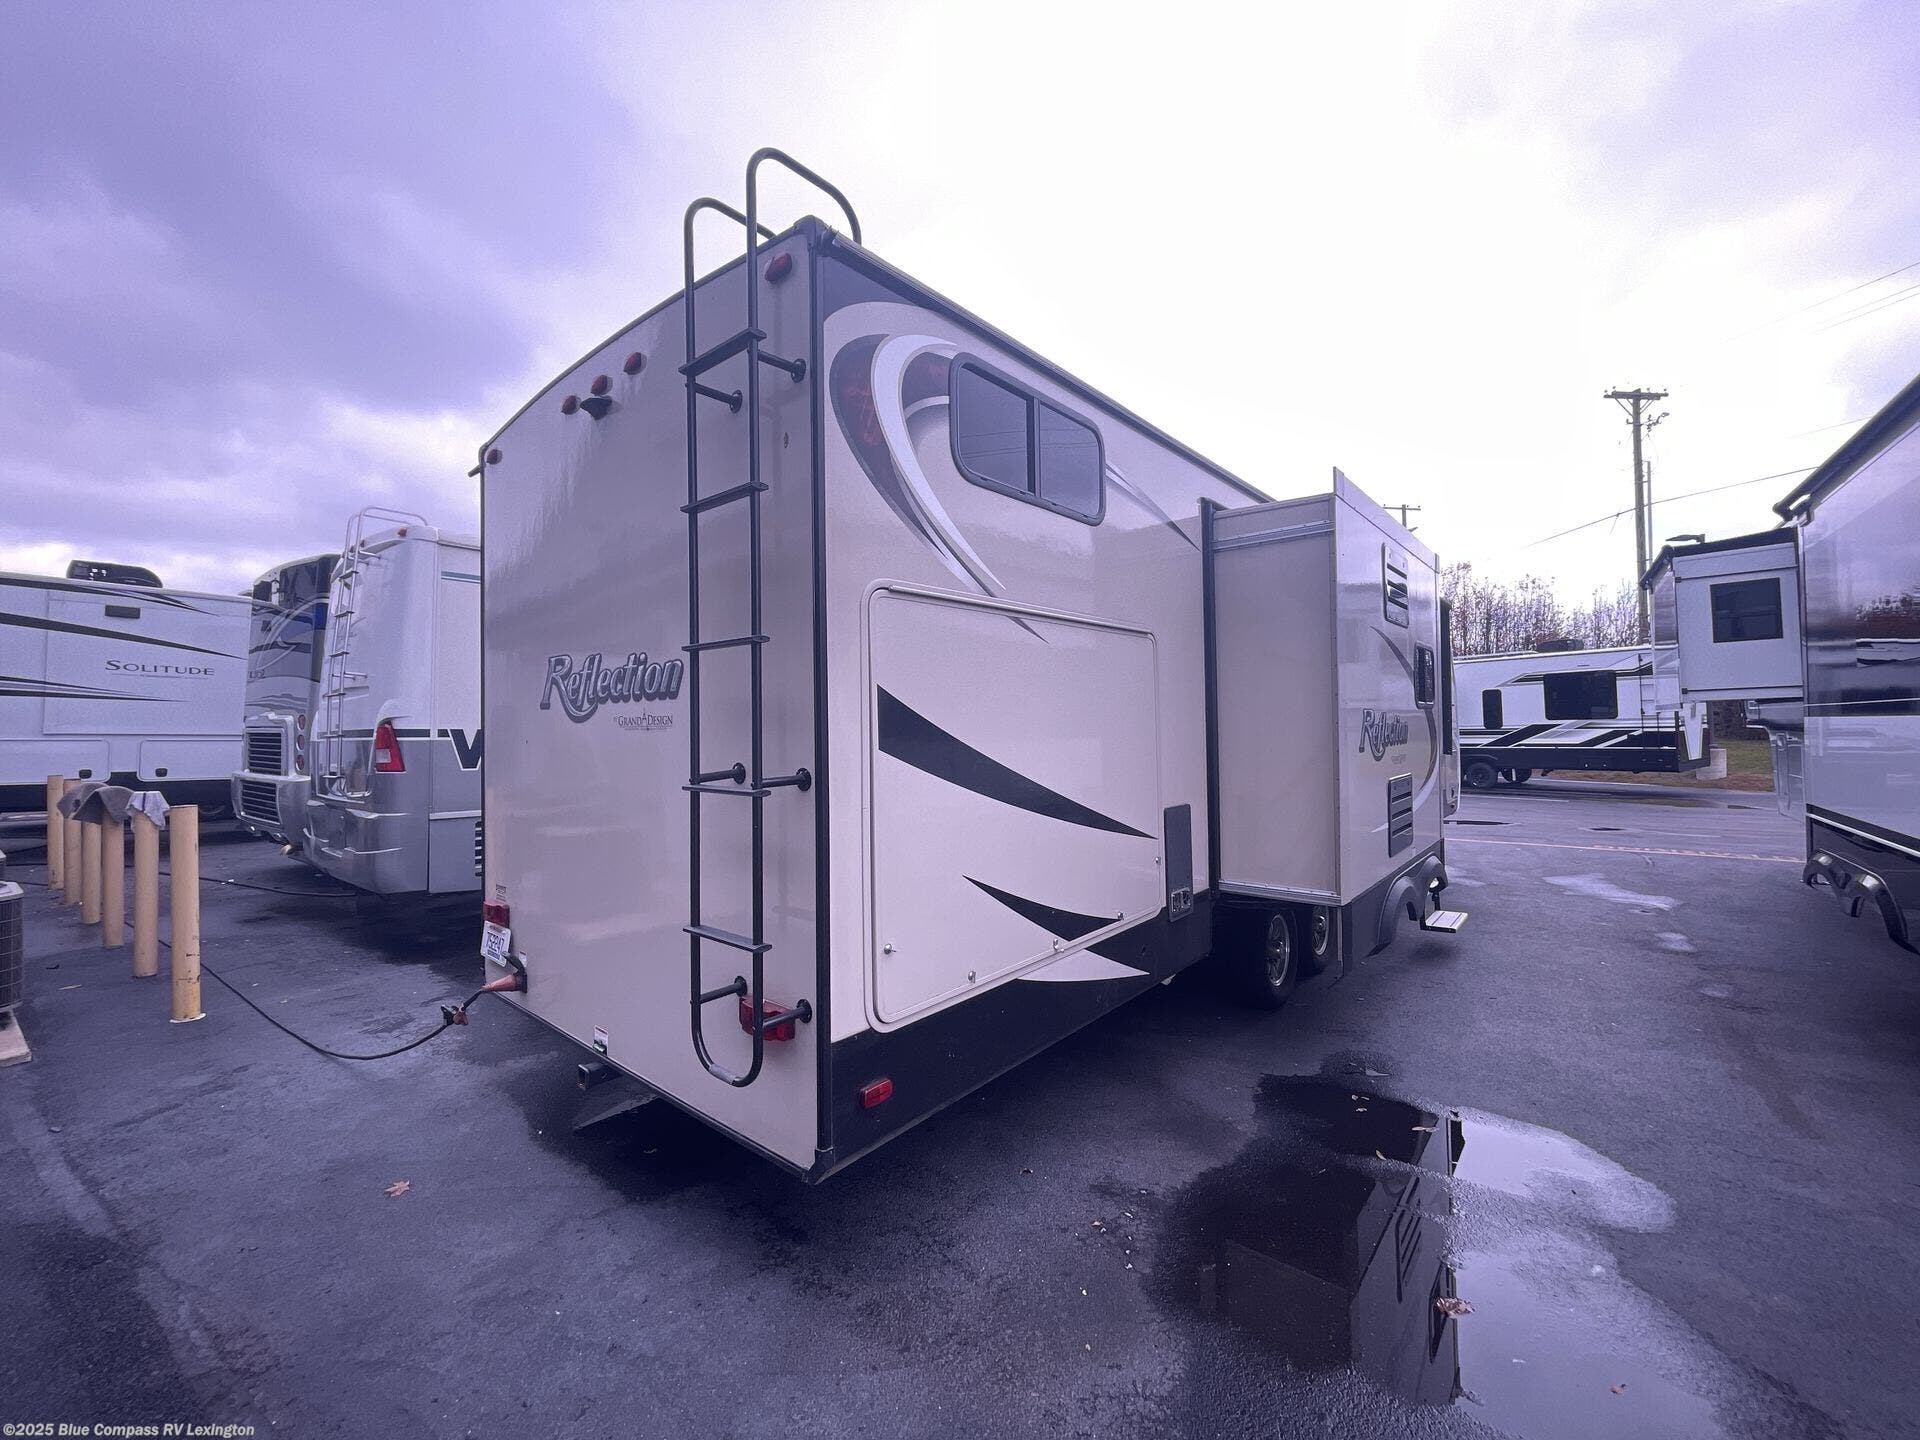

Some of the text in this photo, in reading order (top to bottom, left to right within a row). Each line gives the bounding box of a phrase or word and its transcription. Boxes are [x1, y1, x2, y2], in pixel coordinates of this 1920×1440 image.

[105, 660, 215, 676] SOLITUDE
[540, 652, 685, 724] Reflection
[618, 715, 641, 726] GRAND
[647, 714, 673, 726] DESIGN
[1359, 709, 1408, 761] Reflection
